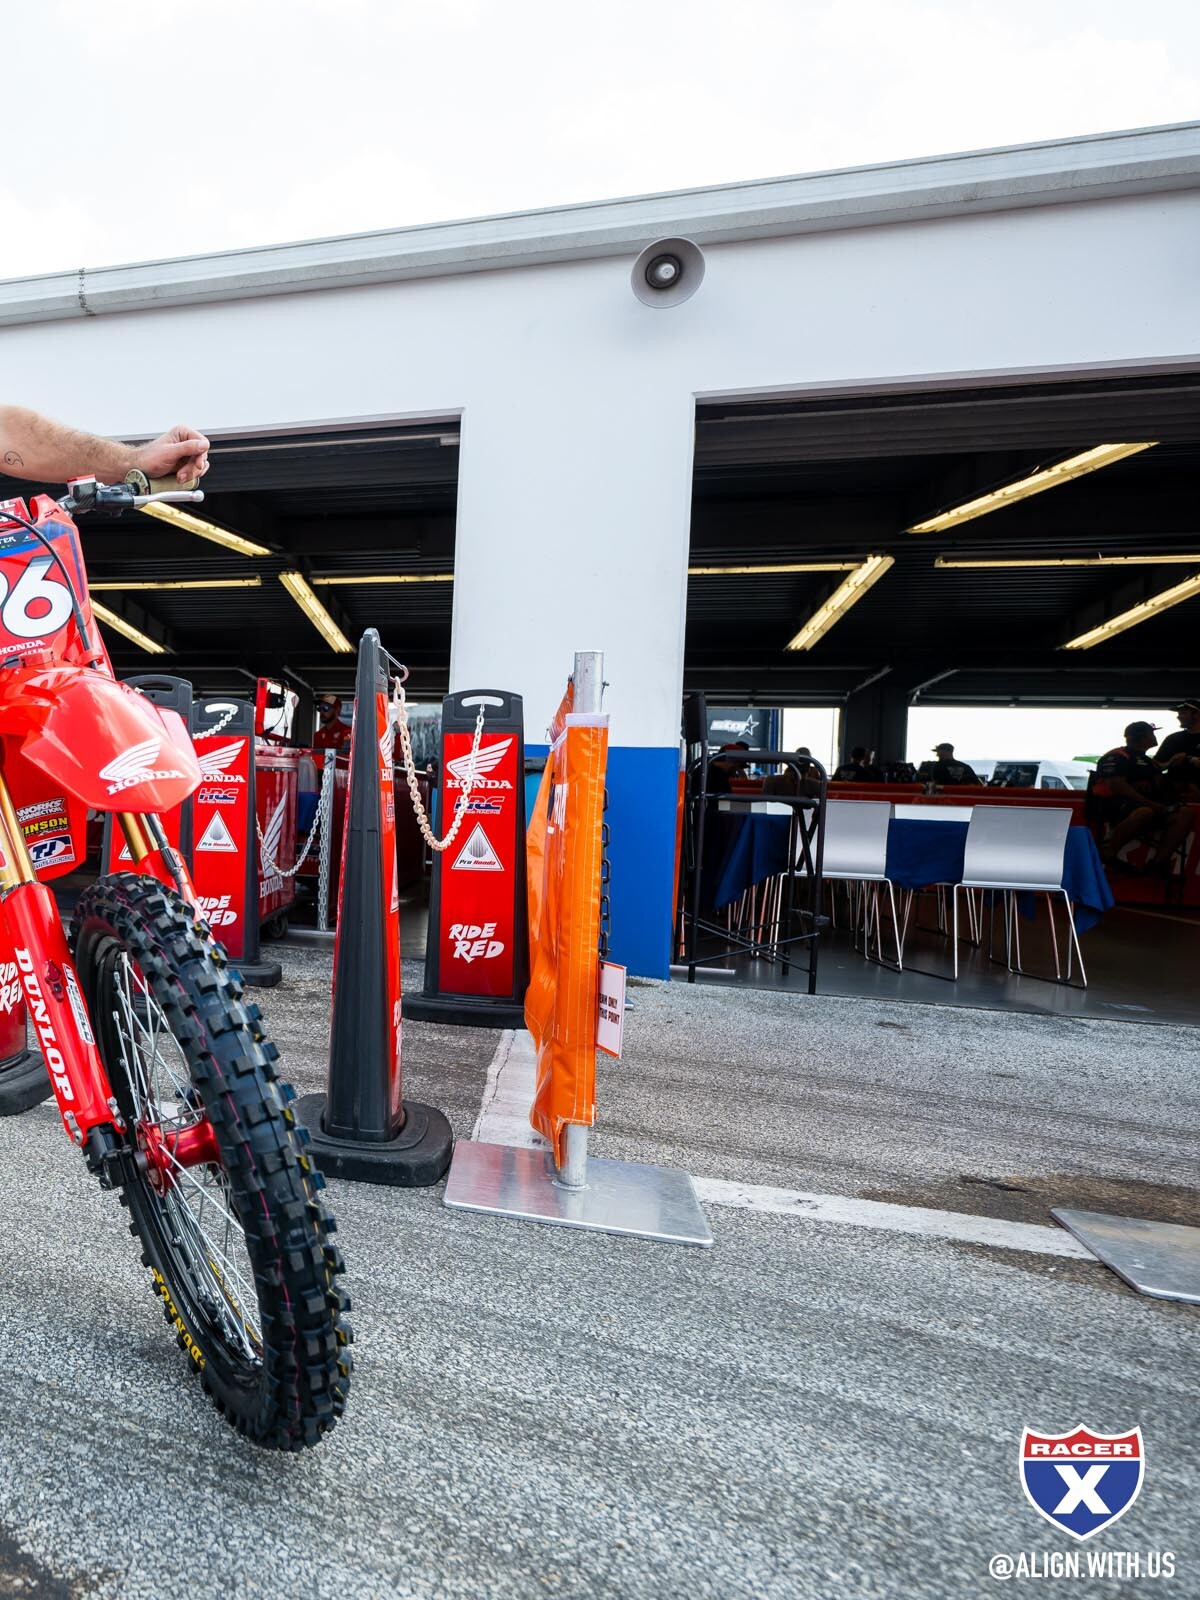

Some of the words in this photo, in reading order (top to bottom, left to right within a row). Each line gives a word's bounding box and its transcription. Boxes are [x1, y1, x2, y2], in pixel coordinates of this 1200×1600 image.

[106, 770, 186, 796] HONDA
[446, 779, 513, 789] HONDA
[198, 787, 239, 800] HRC
[16, 799, 63, 816] WORKS
[32, 841, 57, 859] TJ
[260, 875, 284, 899] HONDA
[449, 922, 498, 942] RIDE
[453, 938, 505, 964] RED
[15, 947, 74, 1100] DUNLOP
